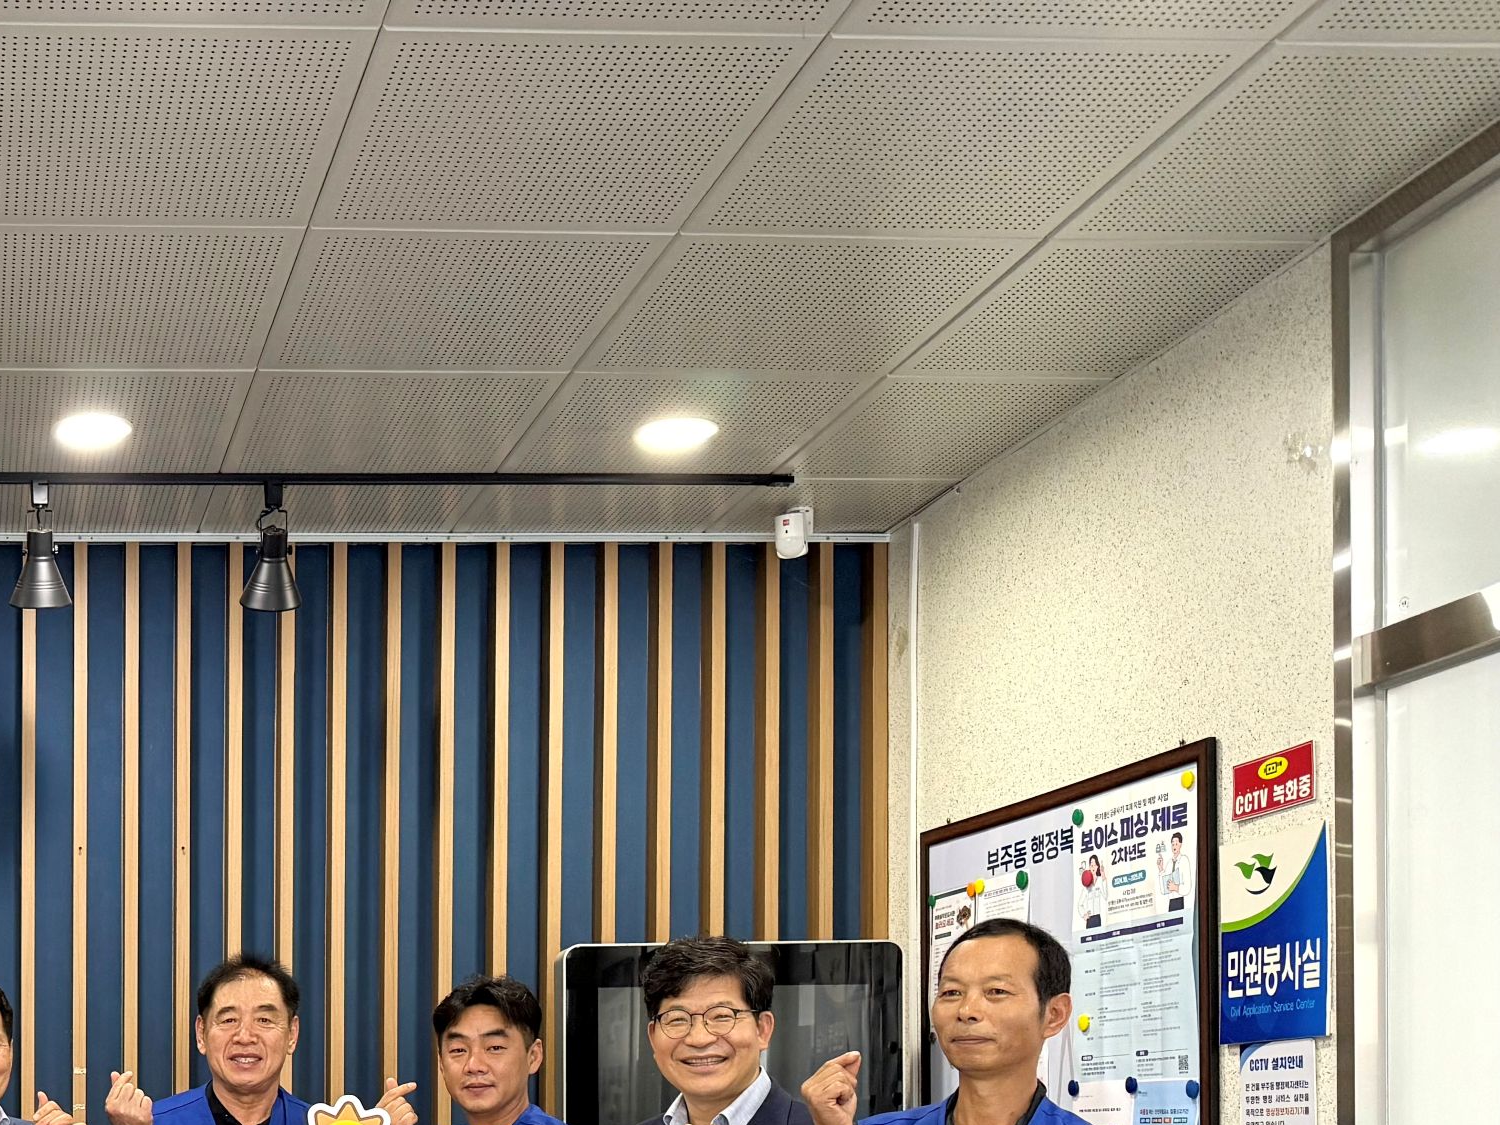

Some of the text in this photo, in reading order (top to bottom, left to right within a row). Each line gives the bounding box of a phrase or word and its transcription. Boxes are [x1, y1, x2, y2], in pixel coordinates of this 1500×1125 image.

[1235, 774, 1311, 815] CCTV 녹화중
[1151, 802, 1188, 833] 제로
[987, 840, 1027, 876] 부주동
[1111, 841, 1146, 866] 2차년도
[1228, 938, 1320, 999] 민원봉사실
[1242, 1003, 1272, 1018] Application
[1273, 1001, 1294, 1013] Service
[1295, 998, 1315, 1011] Center
[1249, 1055, 1304, 1071] CCTV 설치안내
